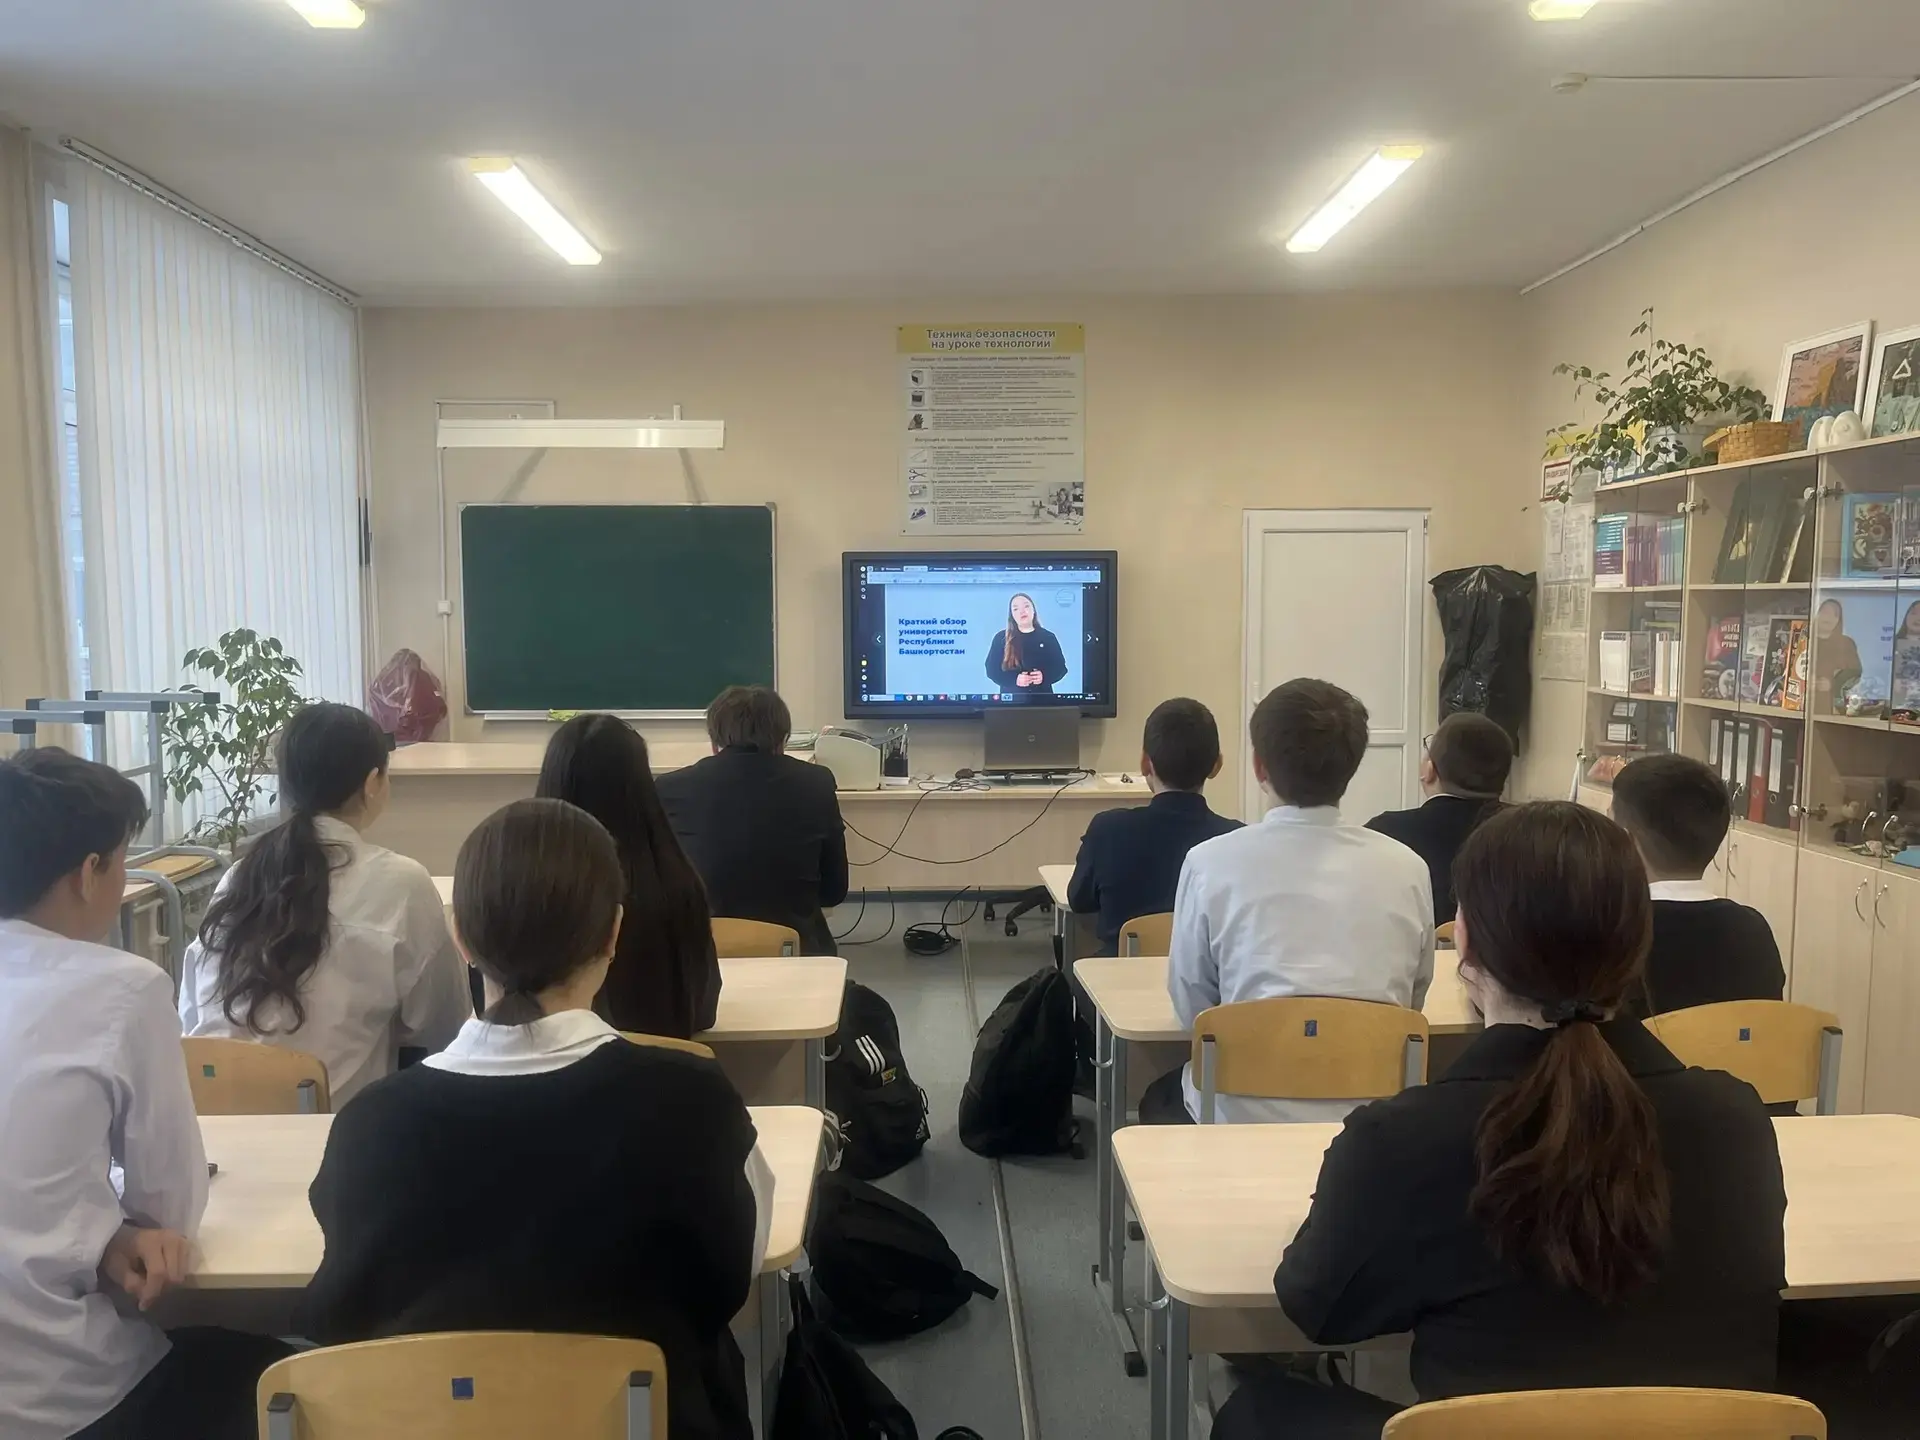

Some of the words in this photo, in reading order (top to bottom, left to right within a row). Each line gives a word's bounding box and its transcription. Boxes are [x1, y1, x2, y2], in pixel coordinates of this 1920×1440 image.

[926, 329, 972, 339] Техника
[975, 329, 1056, 338] безопасности
[948, 340, 981, 350] уроке
[984, 340, 1051, 348] технологии
[898, 617, 937, 626] Краткий
[939, 617, 967, 626] обзор
[898, 629, 968, 637] университетов
[898, 638, 955, 646] Республики
[898, 648, 965, 656] Башкортостан
